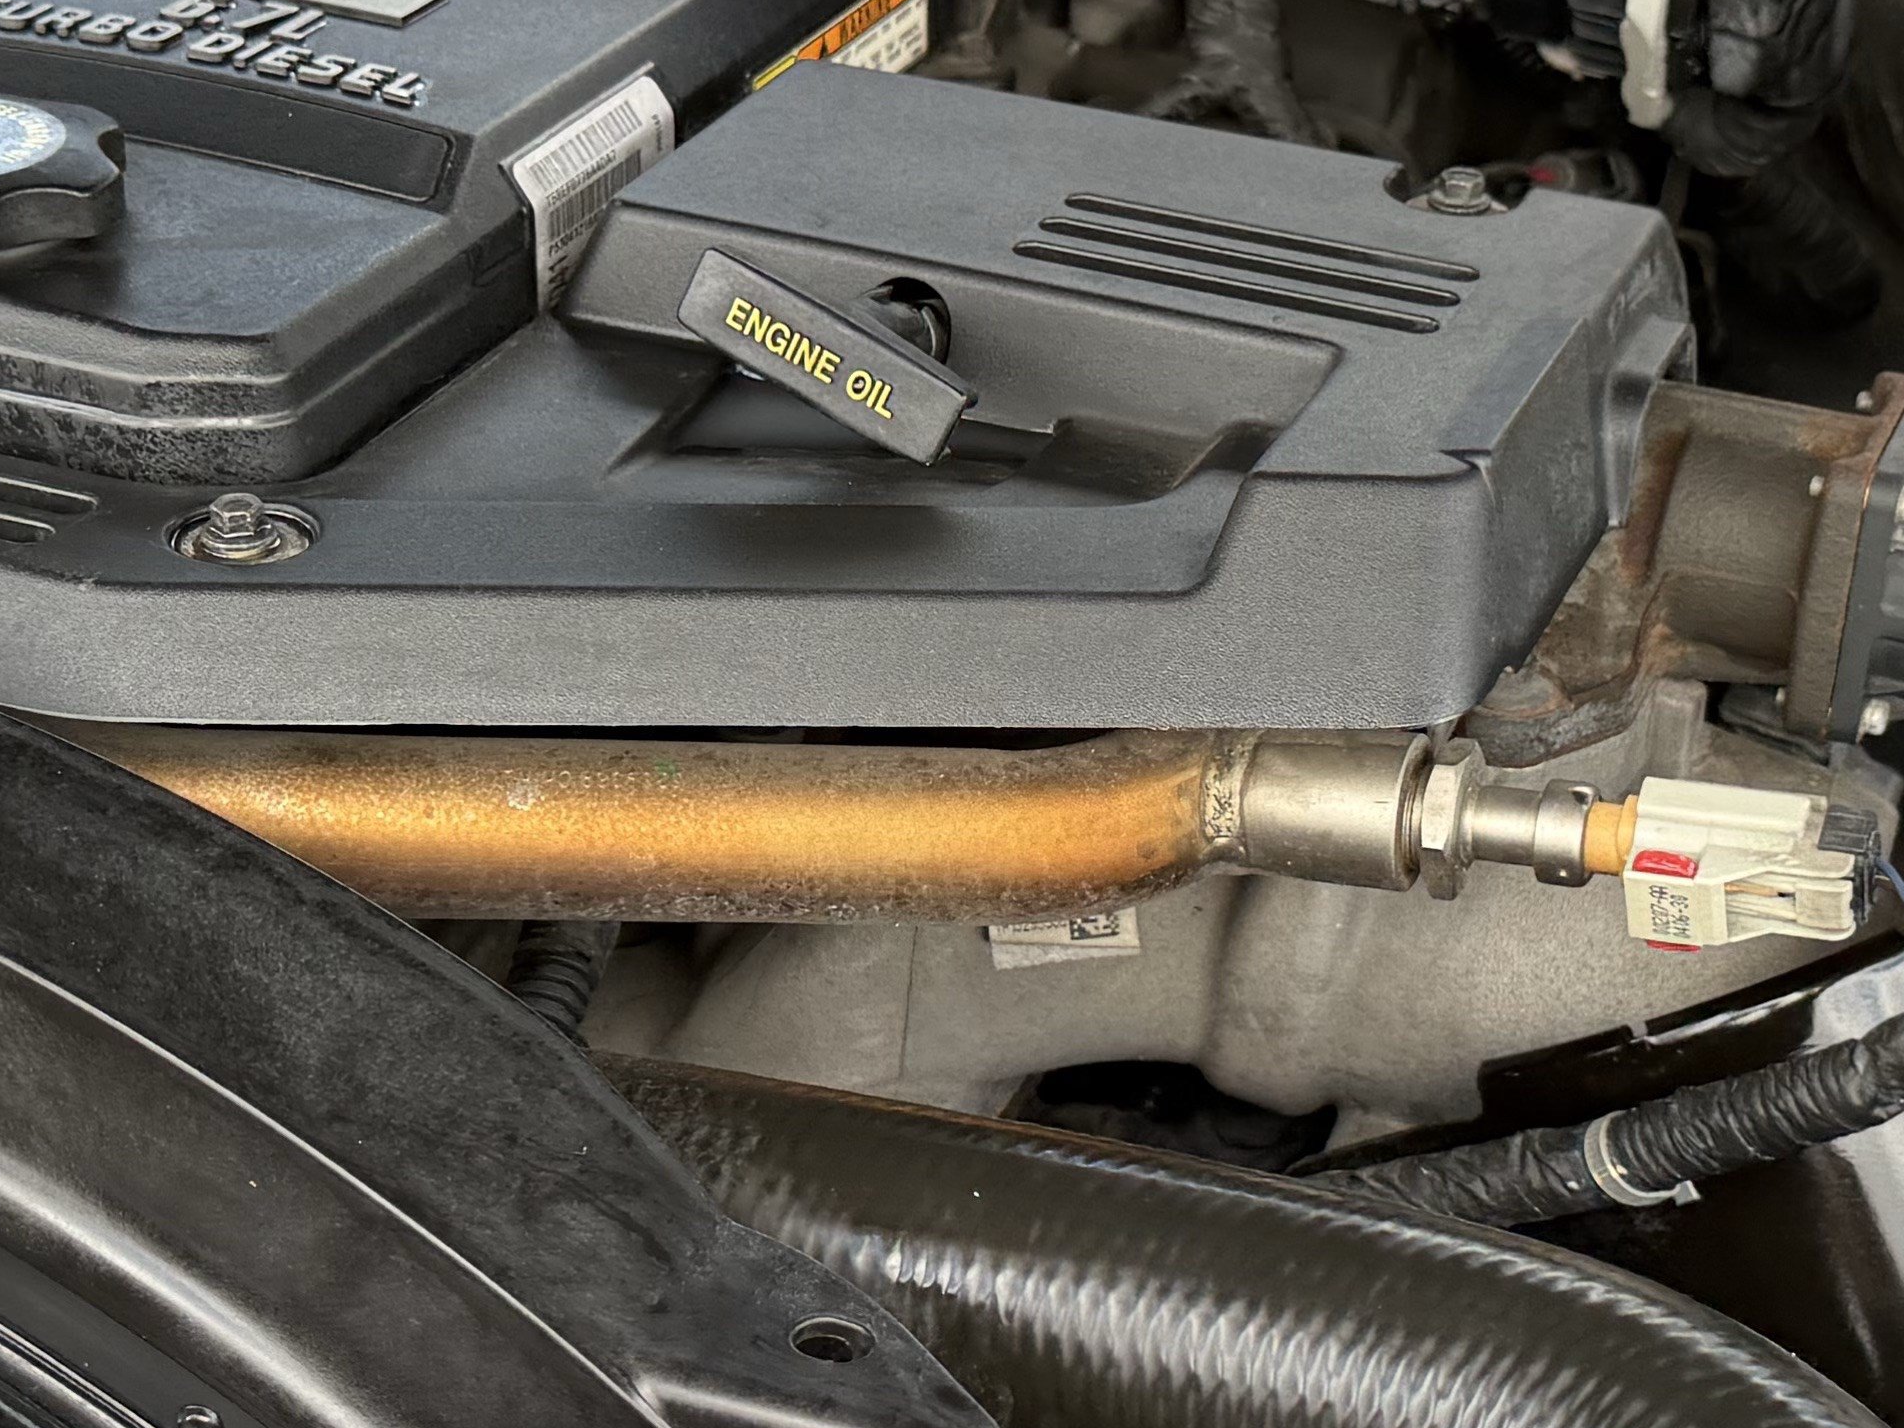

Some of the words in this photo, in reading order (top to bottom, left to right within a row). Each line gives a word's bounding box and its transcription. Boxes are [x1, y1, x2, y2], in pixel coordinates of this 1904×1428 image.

[187, 31, 431, 107] DIESEL
[725, 297, 842, 384] ENGINE
[845, 369, 894, 419] OIL
